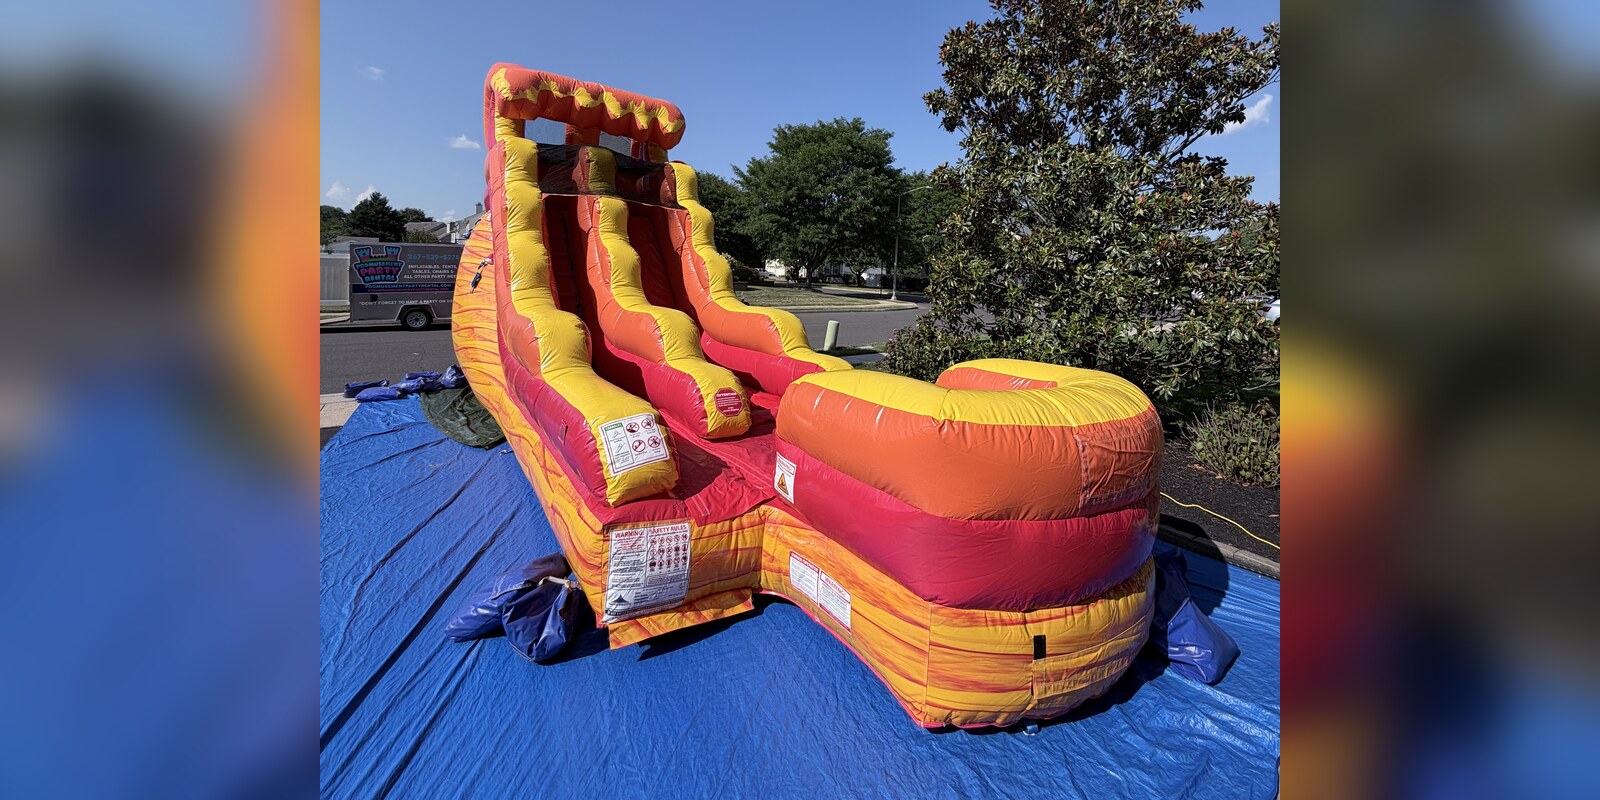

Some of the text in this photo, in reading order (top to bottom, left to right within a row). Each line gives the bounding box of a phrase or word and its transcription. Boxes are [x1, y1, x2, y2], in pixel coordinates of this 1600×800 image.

[360, 266, 400, 276] PARTY
[364, 274, 395, 282] RENTAL
[649, 526, 670, 534] SAFETY
